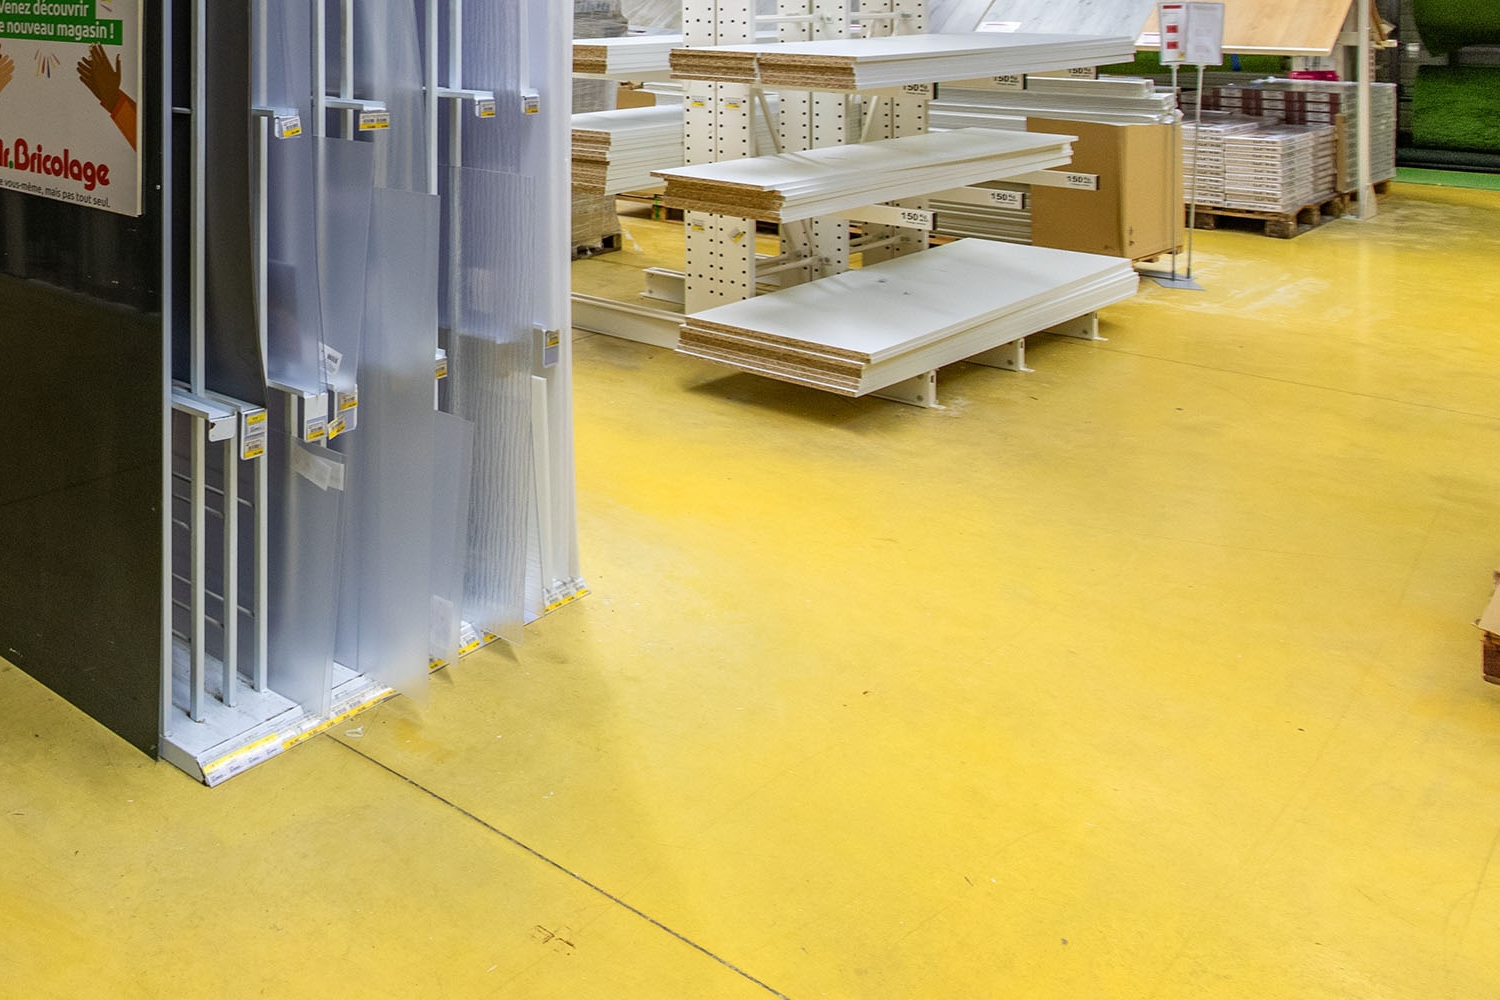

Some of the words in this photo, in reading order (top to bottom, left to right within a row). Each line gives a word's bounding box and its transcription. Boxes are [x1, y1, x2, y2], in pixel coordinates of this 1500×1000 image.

[6, 20, 54, 38] nouveau
[56, 21, 108, 42] magasin
[109, 23, 115, 39] !
[45, 187, 61, 198] mais
[62, 191, 75, 201] pas
[76, 192, 92, 203] tout
[991, 192, 1008, 201] 150
[901, 212, 918, 221] 150
